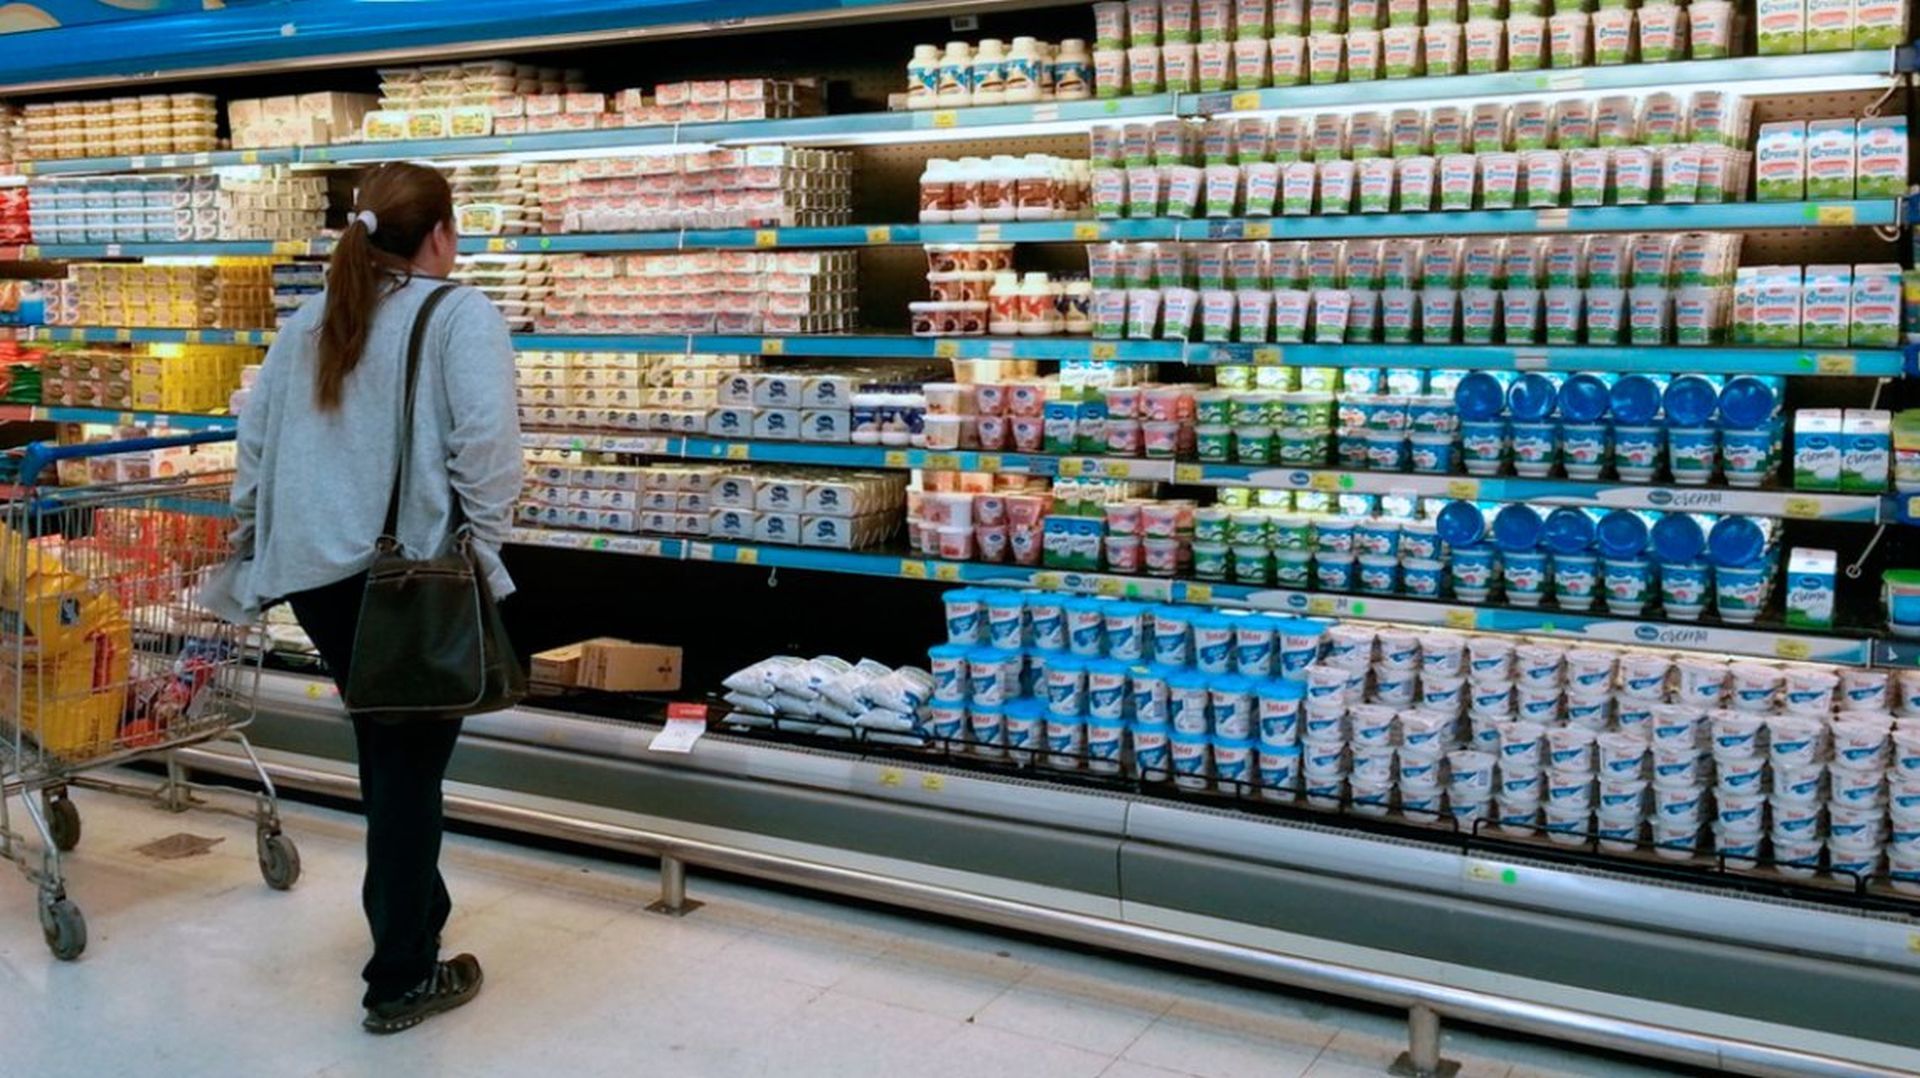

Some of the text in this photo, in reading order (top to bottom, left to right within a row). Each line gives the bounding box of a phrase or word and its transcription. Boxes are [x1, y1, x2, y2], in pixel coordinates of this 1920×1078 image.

[1760, 147, 1799, 161] Crema
[1811, 146, 1850, 159] Crema
[1861, 144, 1902, 157] Crema
[1756, 292, 1797, 305] Crema
[1806, 291, 1847, 304] Crema
[1854, 290, 1896, 303] Crema
